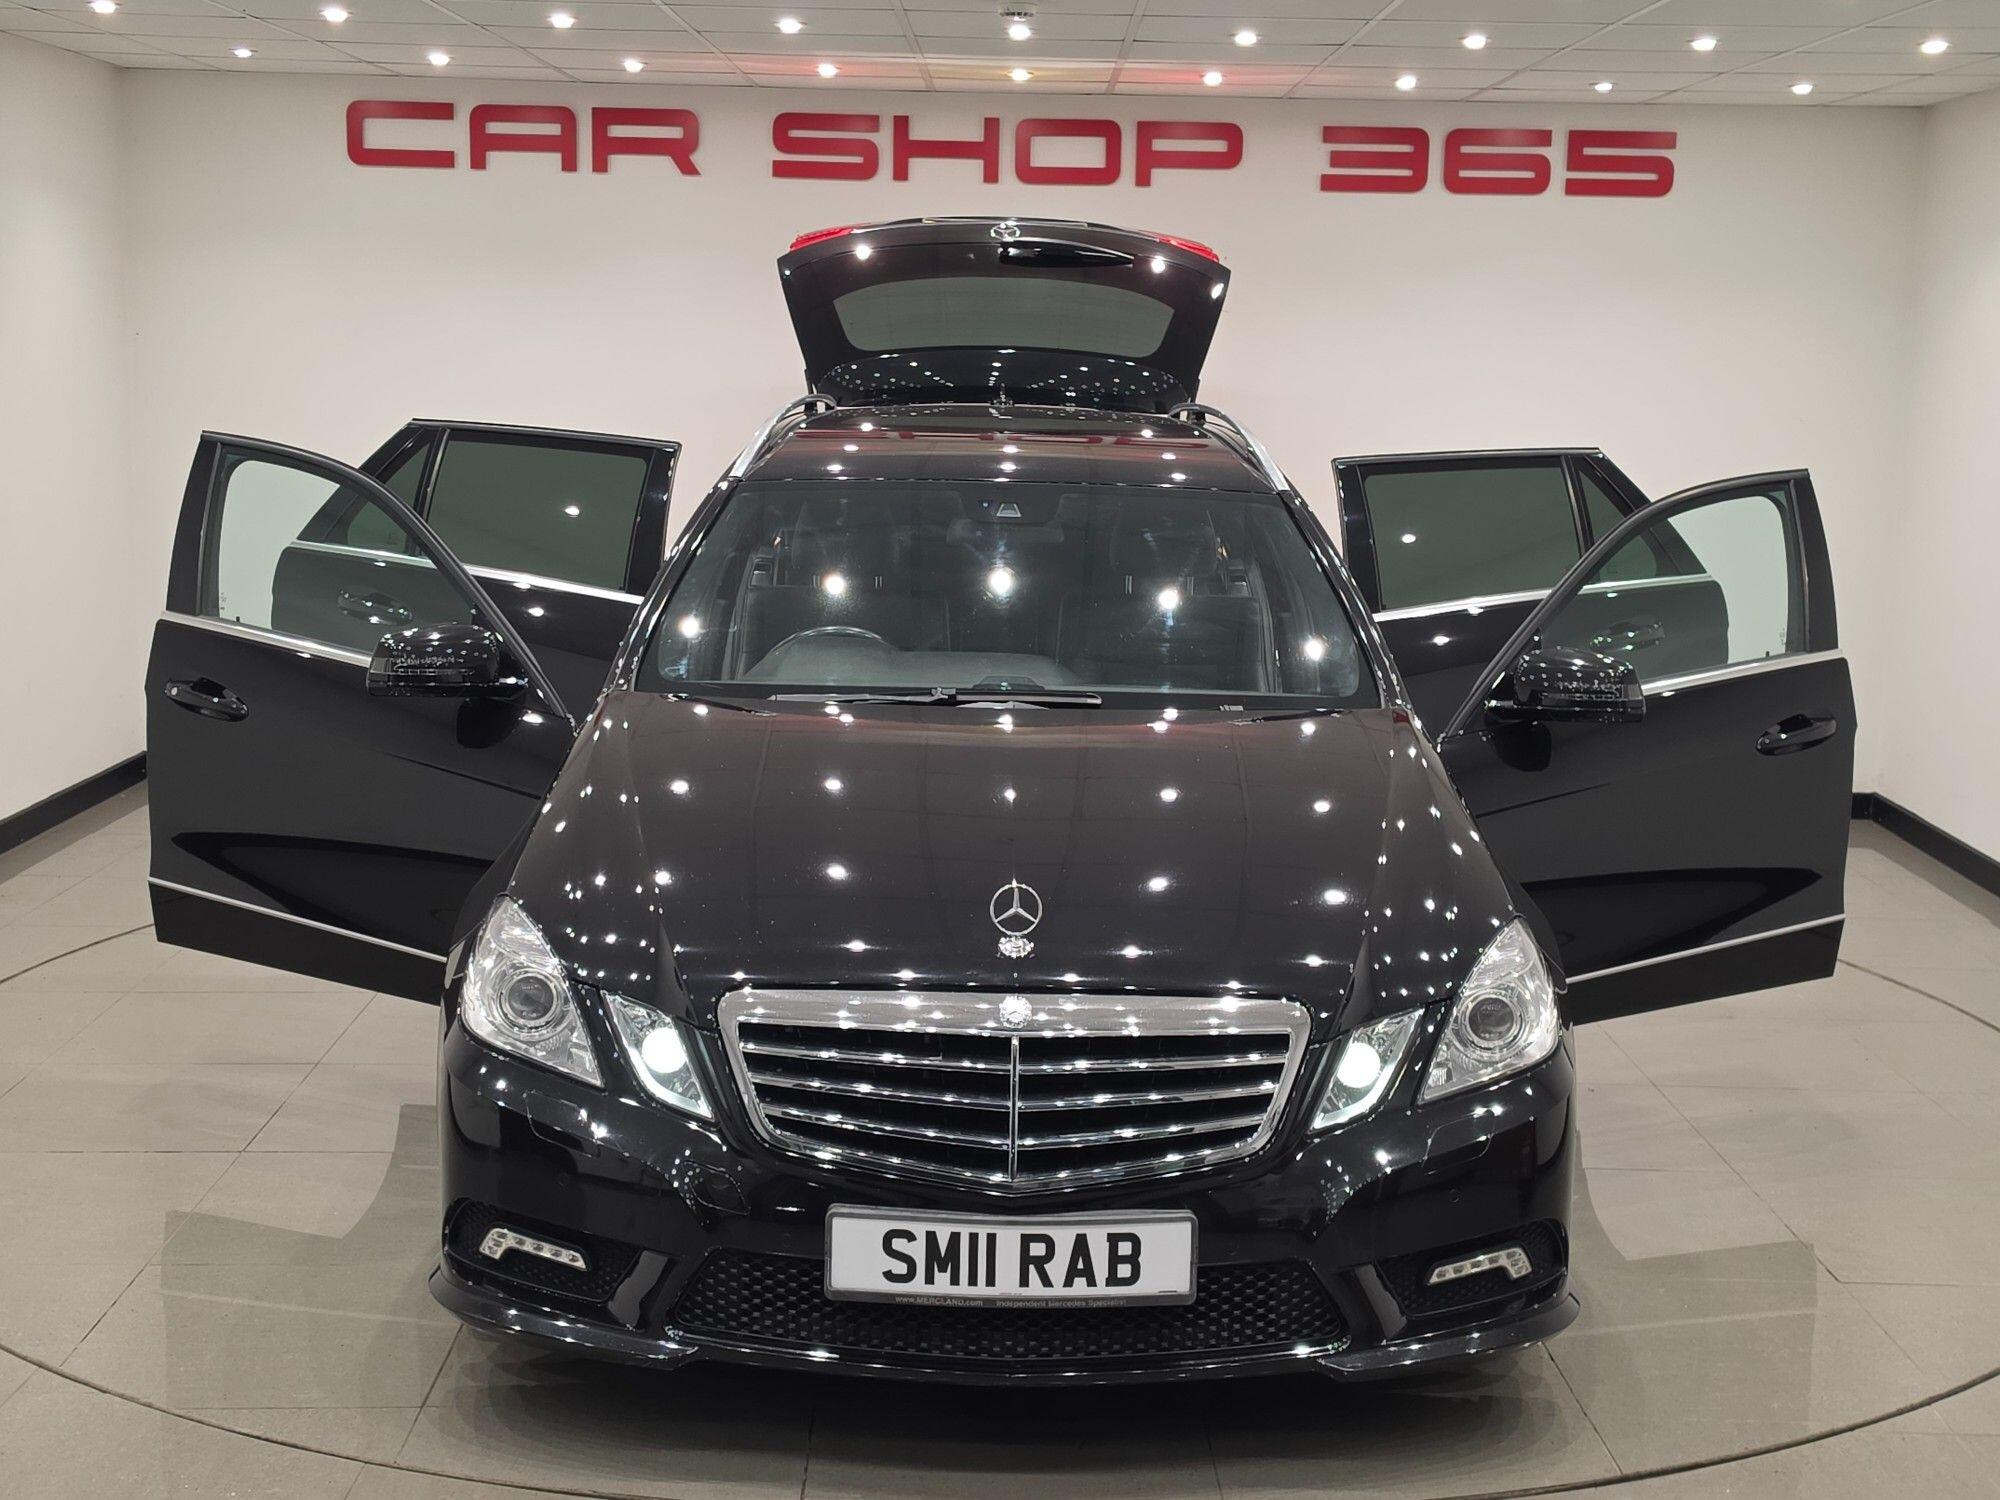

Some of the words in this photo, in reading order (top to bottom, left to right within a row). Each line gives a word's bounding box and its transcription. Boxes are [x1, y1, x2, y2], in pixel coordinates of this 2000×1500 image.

[346, 99, 702, 176] CAR
[772, 111, 1243, 187] SHOP
[1320, 125, 1677, 198] 365
[1018, 1232, 1142, 1288] RAB
[996, 1300, 1046, 1309] Independent
